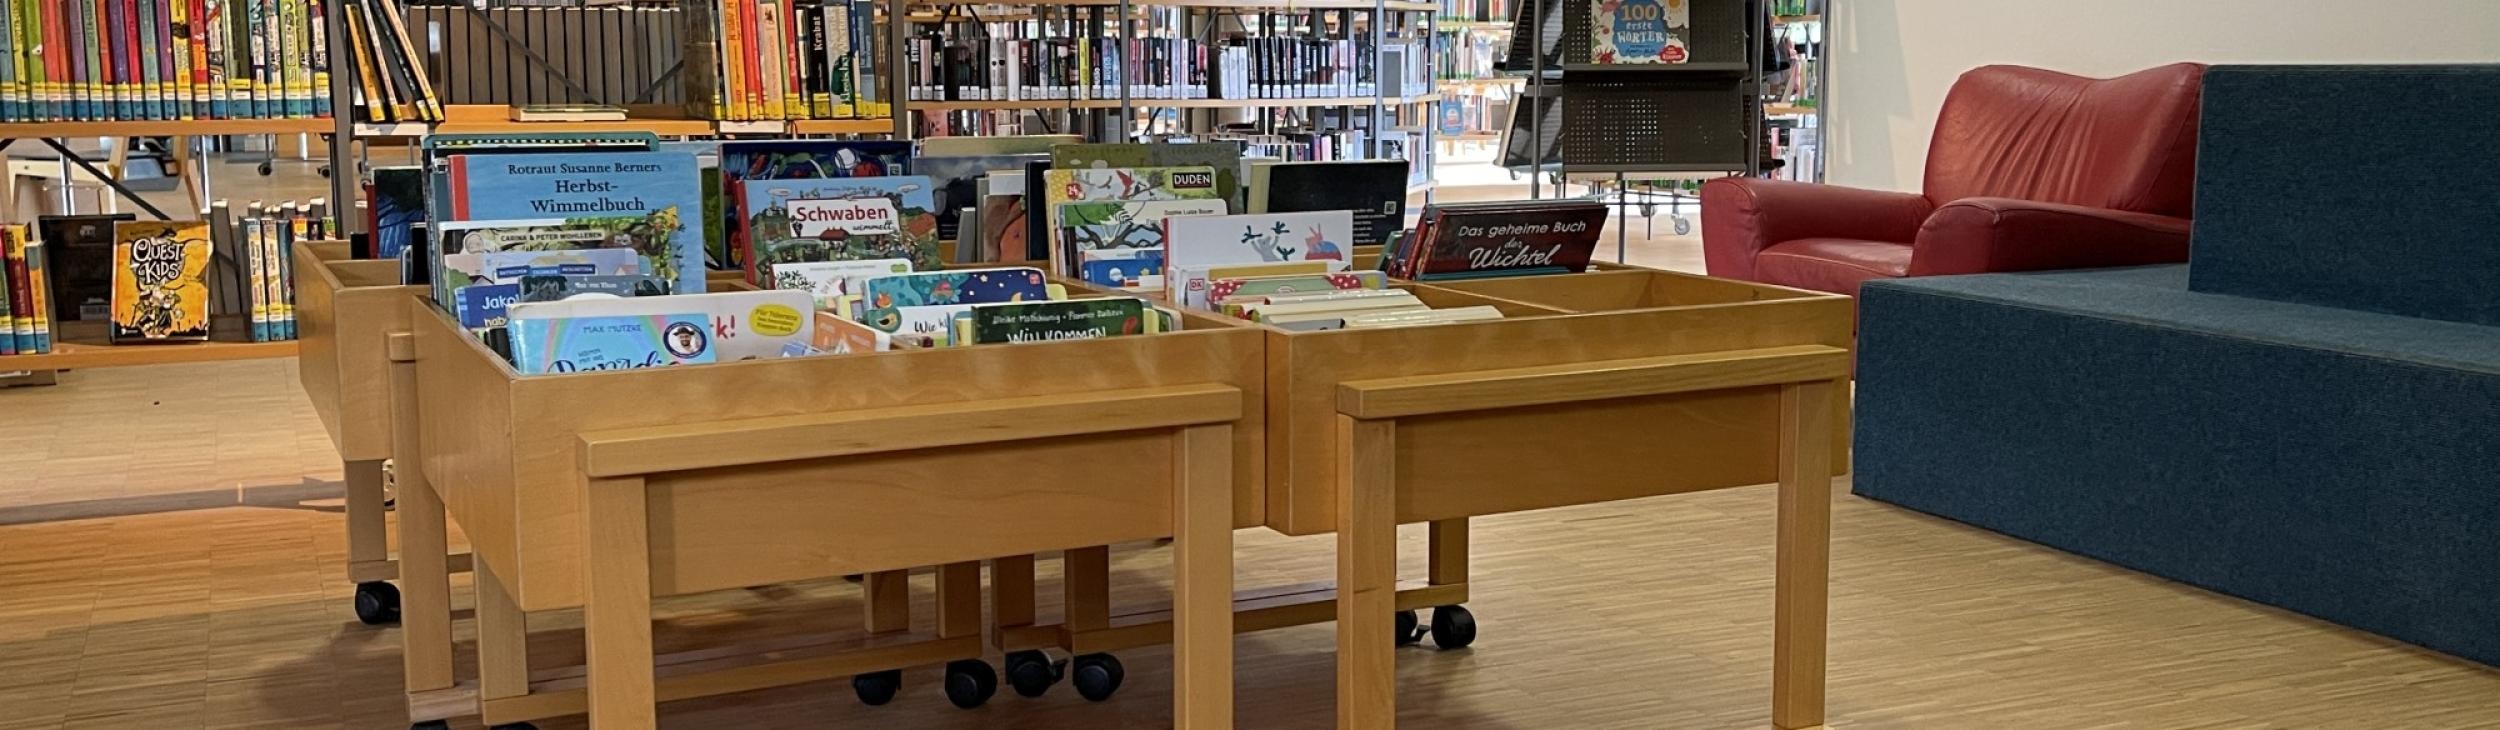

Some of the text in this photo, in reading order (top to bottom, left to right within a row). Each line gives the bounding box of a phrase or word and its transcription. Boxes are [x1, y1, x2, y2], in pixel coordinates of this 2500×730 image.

[1621, 4, 1657, 21] 100
[812, 15, 823, 51] Krabat
[508, 162, 662, 175] Rotraut Susanne Berners
[554, 179, 619, 193] Herbst-
[1174, 174, 1211, 185] DUDEN
[530, 197, 645, 213] Wimmelbuch
[796, 205, 888, 222] Schwaben
[1458, 221, 1586, 238] Das geheime Buch
[133, 238, 184, 262] QUEST
[1469, 244, 1562, 270] Wichtel
[583, 326, 603, 334] MAX
[914, 320, 936, 333] Wie
